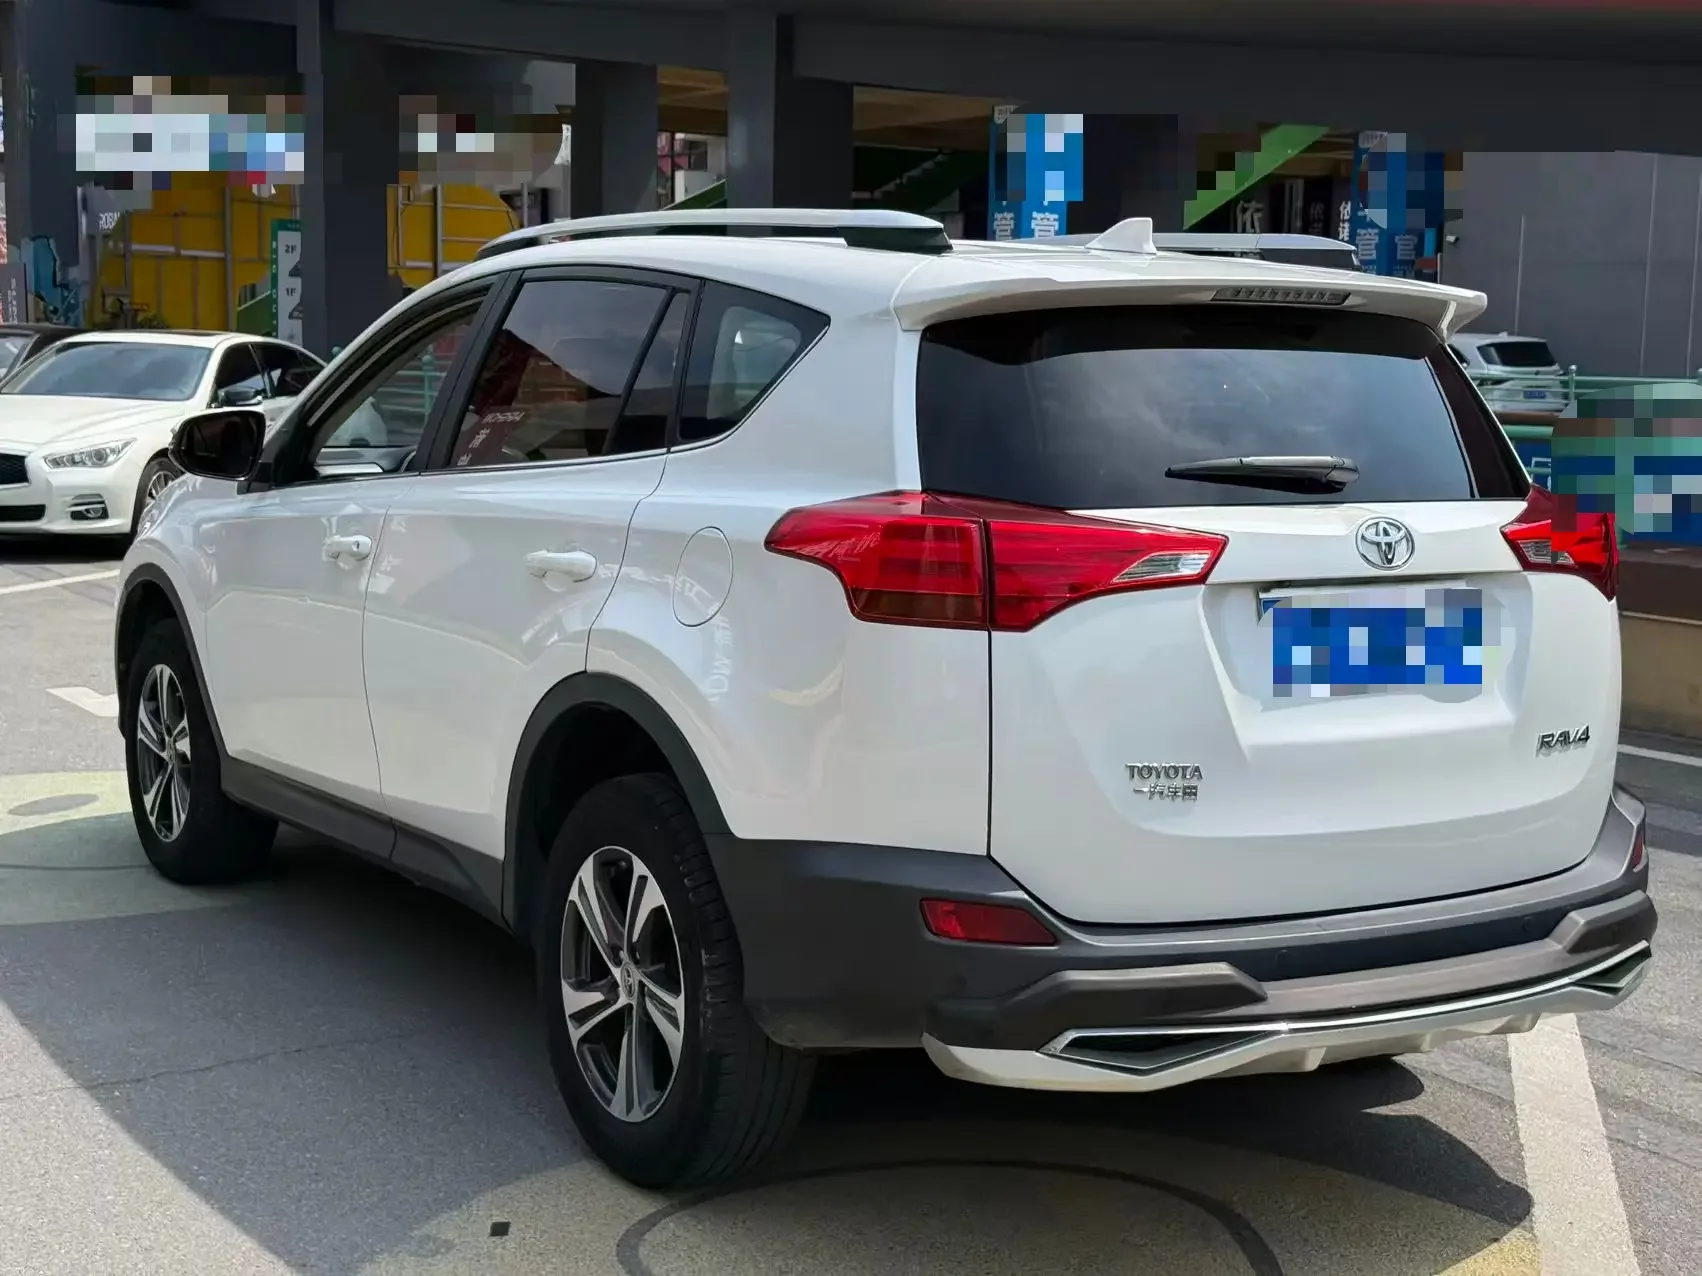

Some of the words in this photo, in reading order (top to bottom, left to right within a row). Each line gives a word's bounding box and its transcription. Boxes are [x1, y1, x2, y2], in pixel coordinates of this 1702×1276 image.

[284, 244, 297, 254] 2F
[285, 288, 296, 297] 1F
[1535, 724, 1591, 752] RAV4
[1125, 762, 1204, 781] TOYOTA
